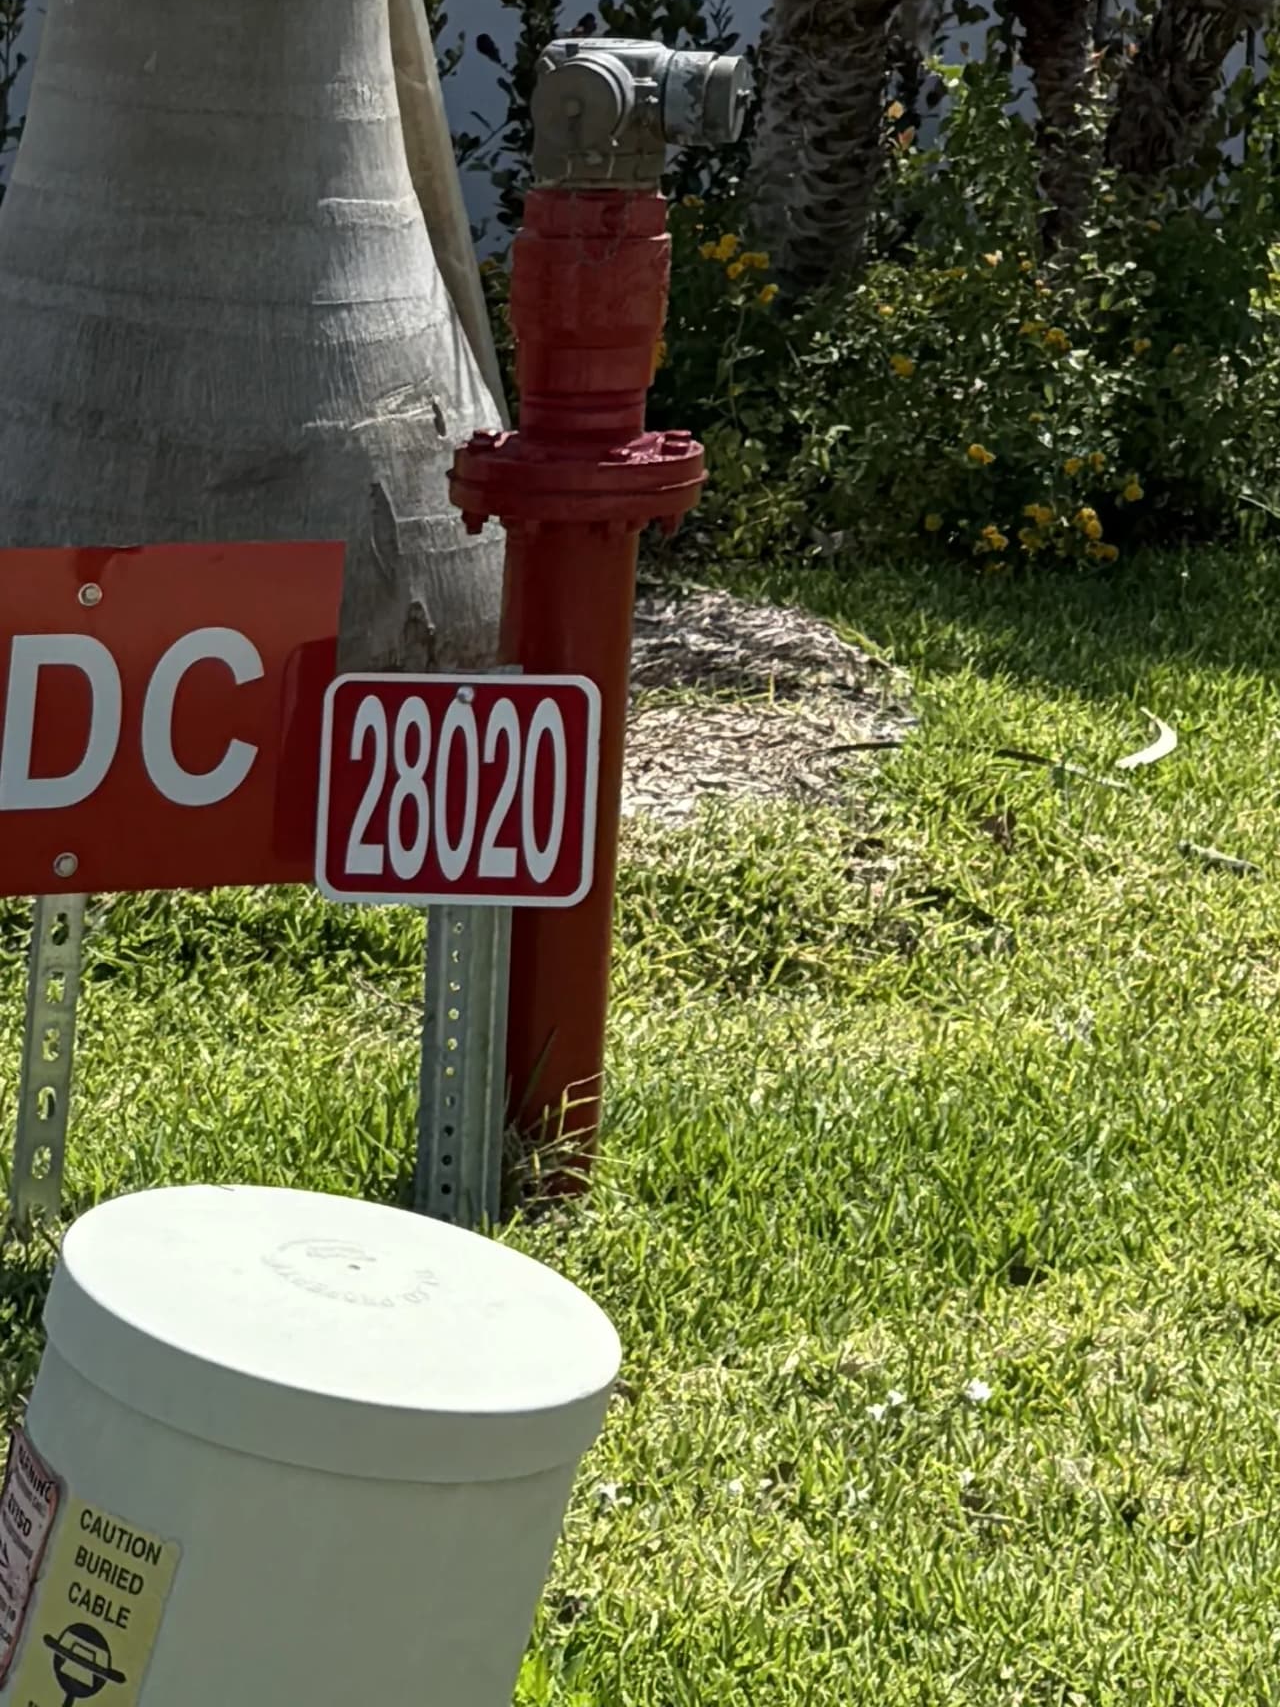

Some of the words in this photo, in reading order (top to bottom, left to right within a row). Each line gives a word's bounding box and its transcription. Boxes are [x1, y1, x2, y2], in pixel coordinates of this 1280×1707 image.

[0, 626, 265, 811] DC
[344, 694, 568, 884] 28020
[80, 1508, 162, 1566] CAUTION
[74, 1545, 144, 1596] BURIED
[68, 1581, 131, 1629] CABLE
